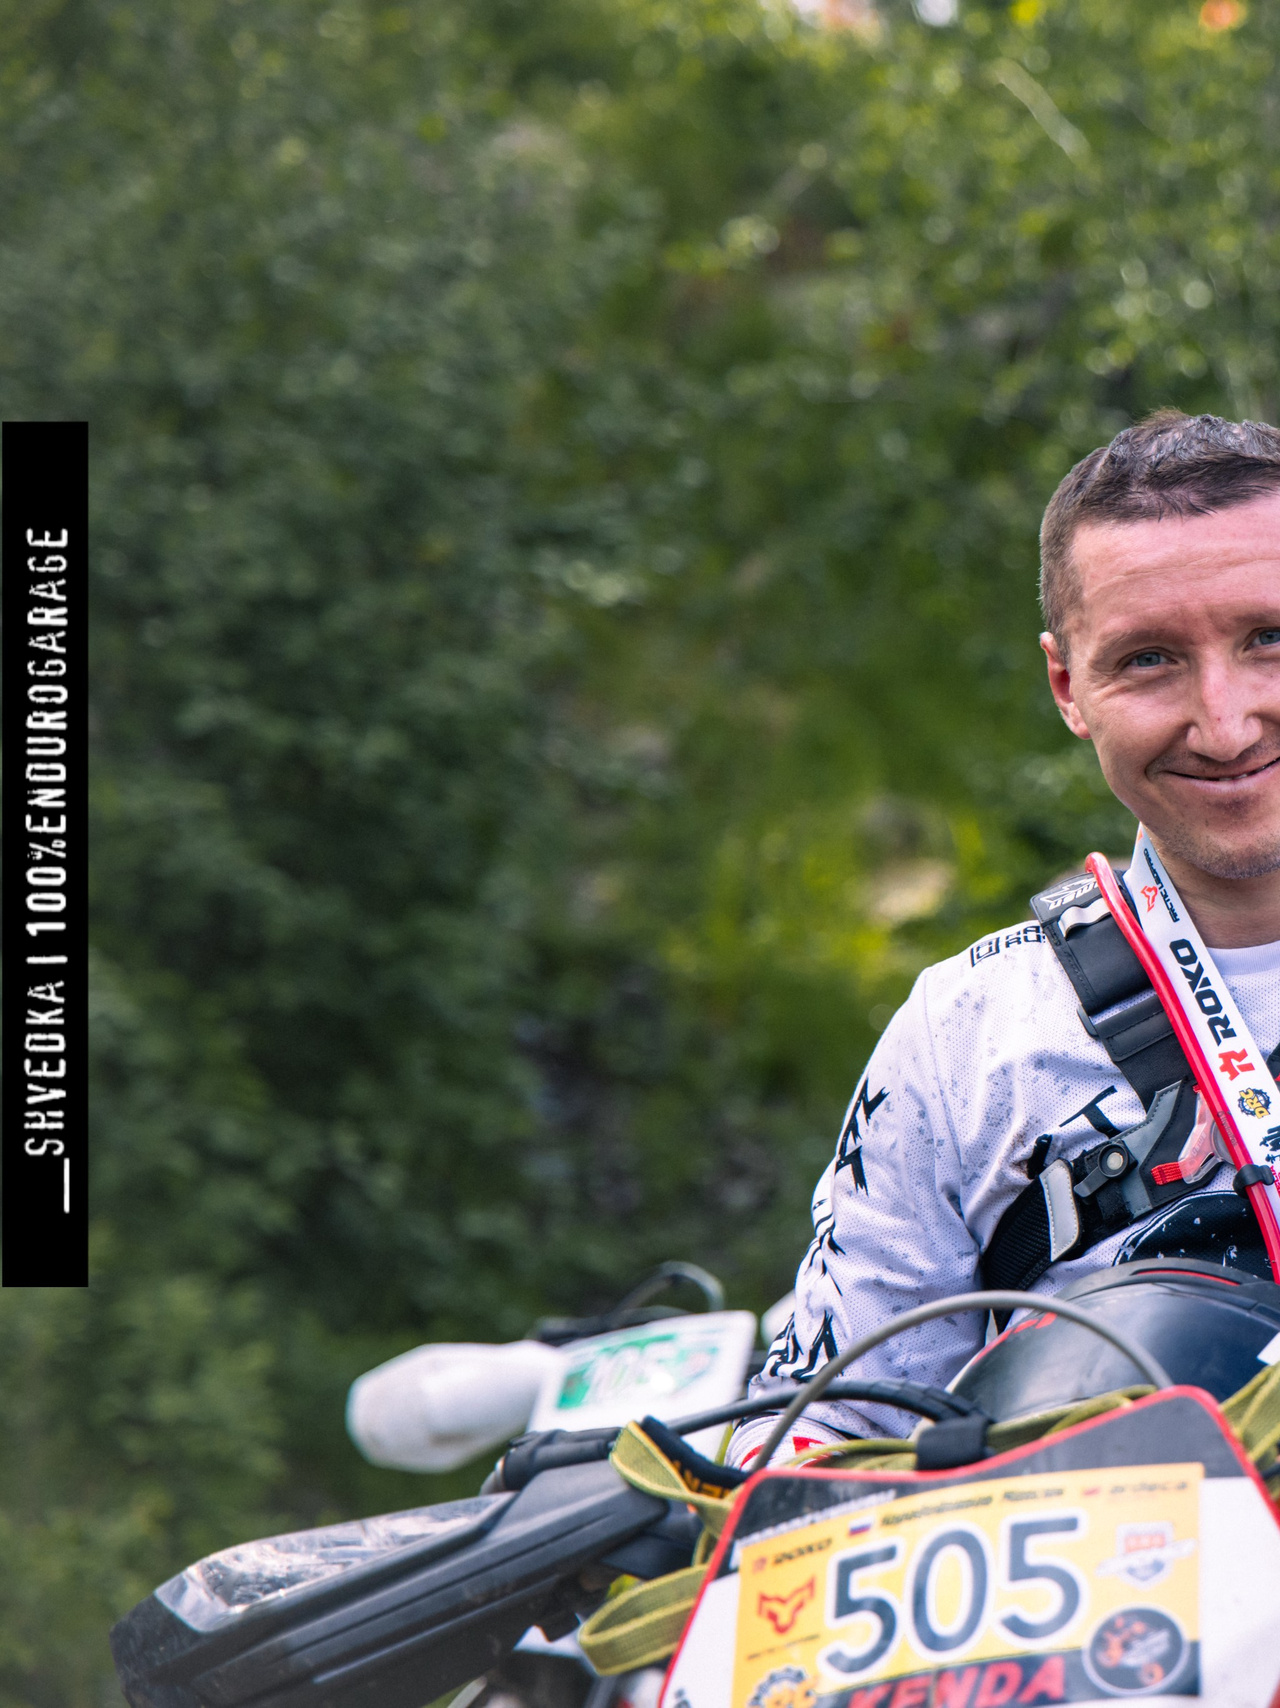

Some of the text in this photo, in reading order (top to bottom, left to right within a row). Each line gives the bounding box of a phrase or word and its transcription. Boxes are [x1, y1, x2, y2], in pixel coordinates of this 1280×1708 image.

[1159, 888, 1180, 923] ARCTIC
[1169, 938, 1237, 1046] ROKO
[1240, 1087, 1271, 1119] DRC
[823, 1515, 1081, 1672] 505
